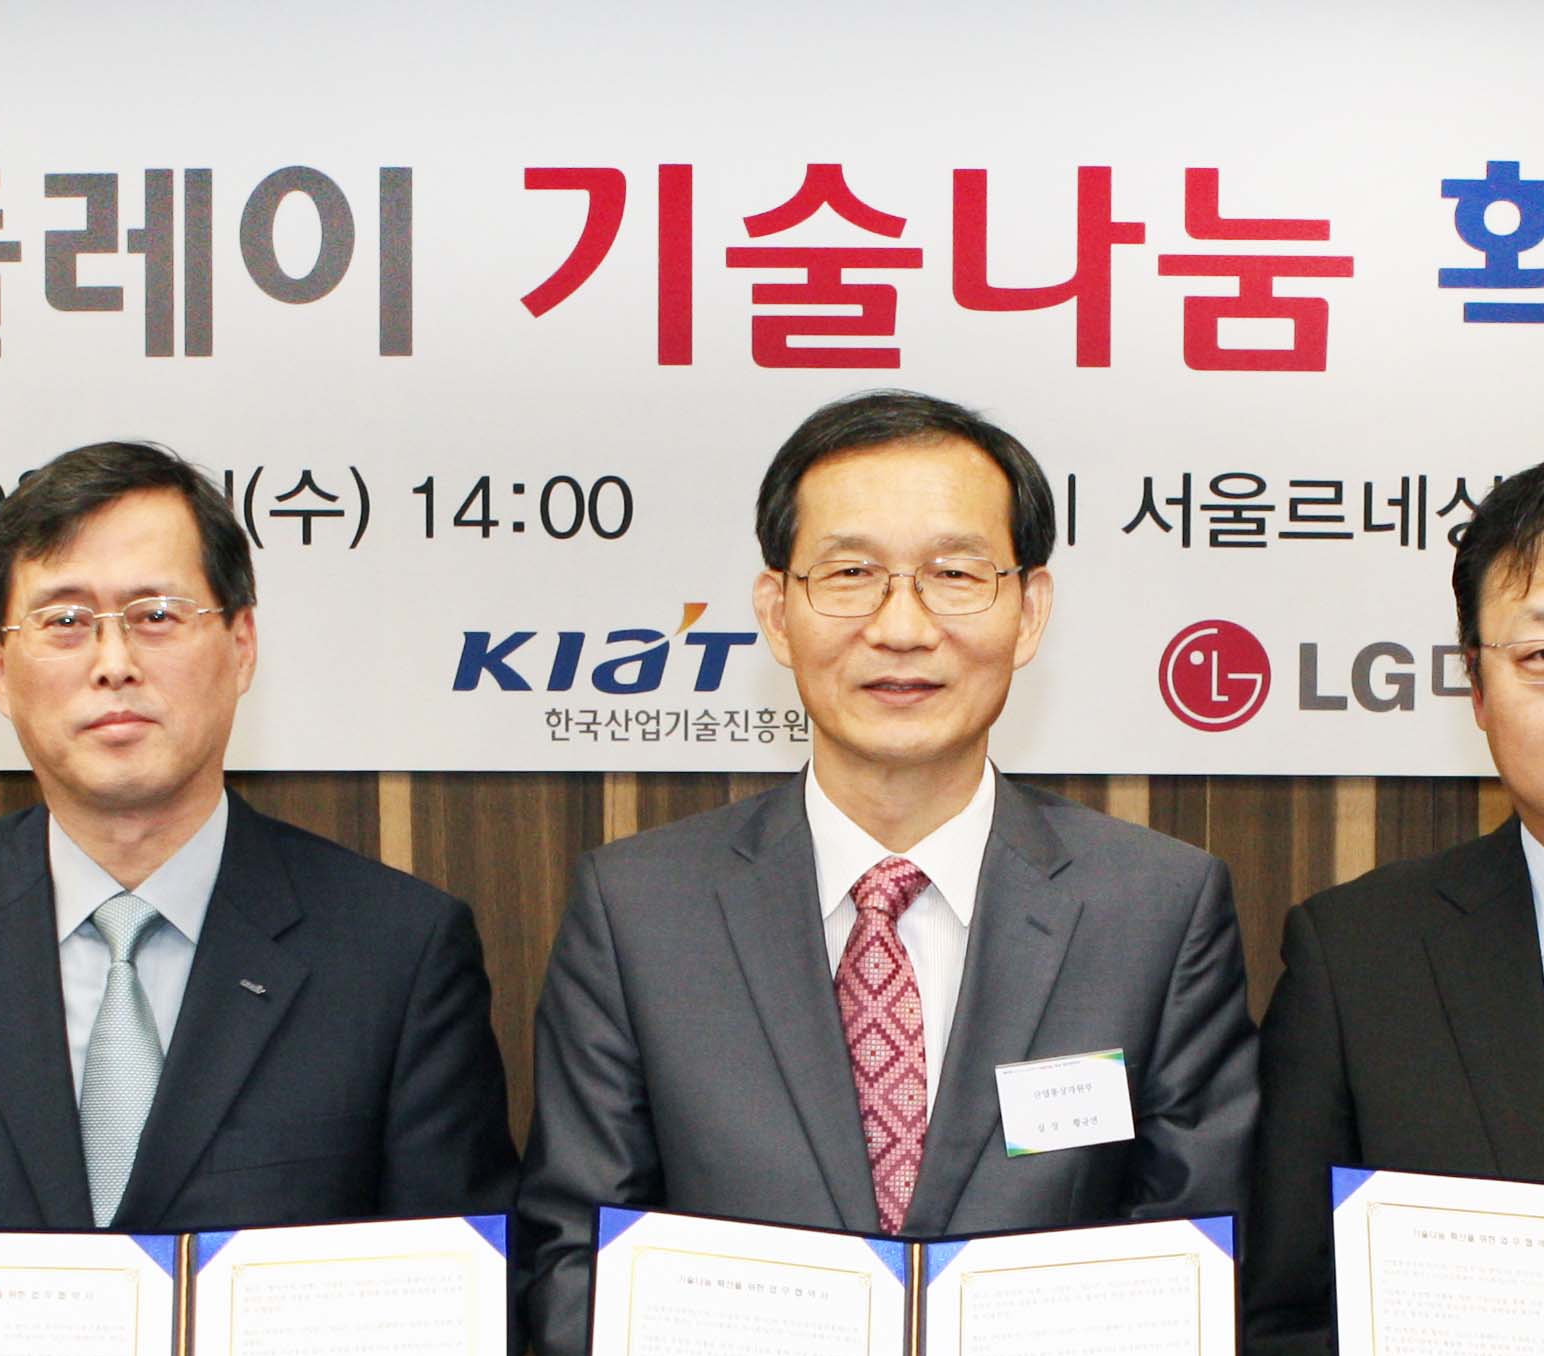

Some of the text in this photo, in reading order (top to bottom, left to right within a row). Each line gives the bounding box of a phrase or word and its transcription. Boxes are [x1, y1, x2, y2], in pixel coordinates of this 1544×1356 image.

[520, 162, 1355, 372] 기술나눔
[412, 474, 634, 541] 14:00
[544, 708, 809, 744] 한국산업기술진흥원
